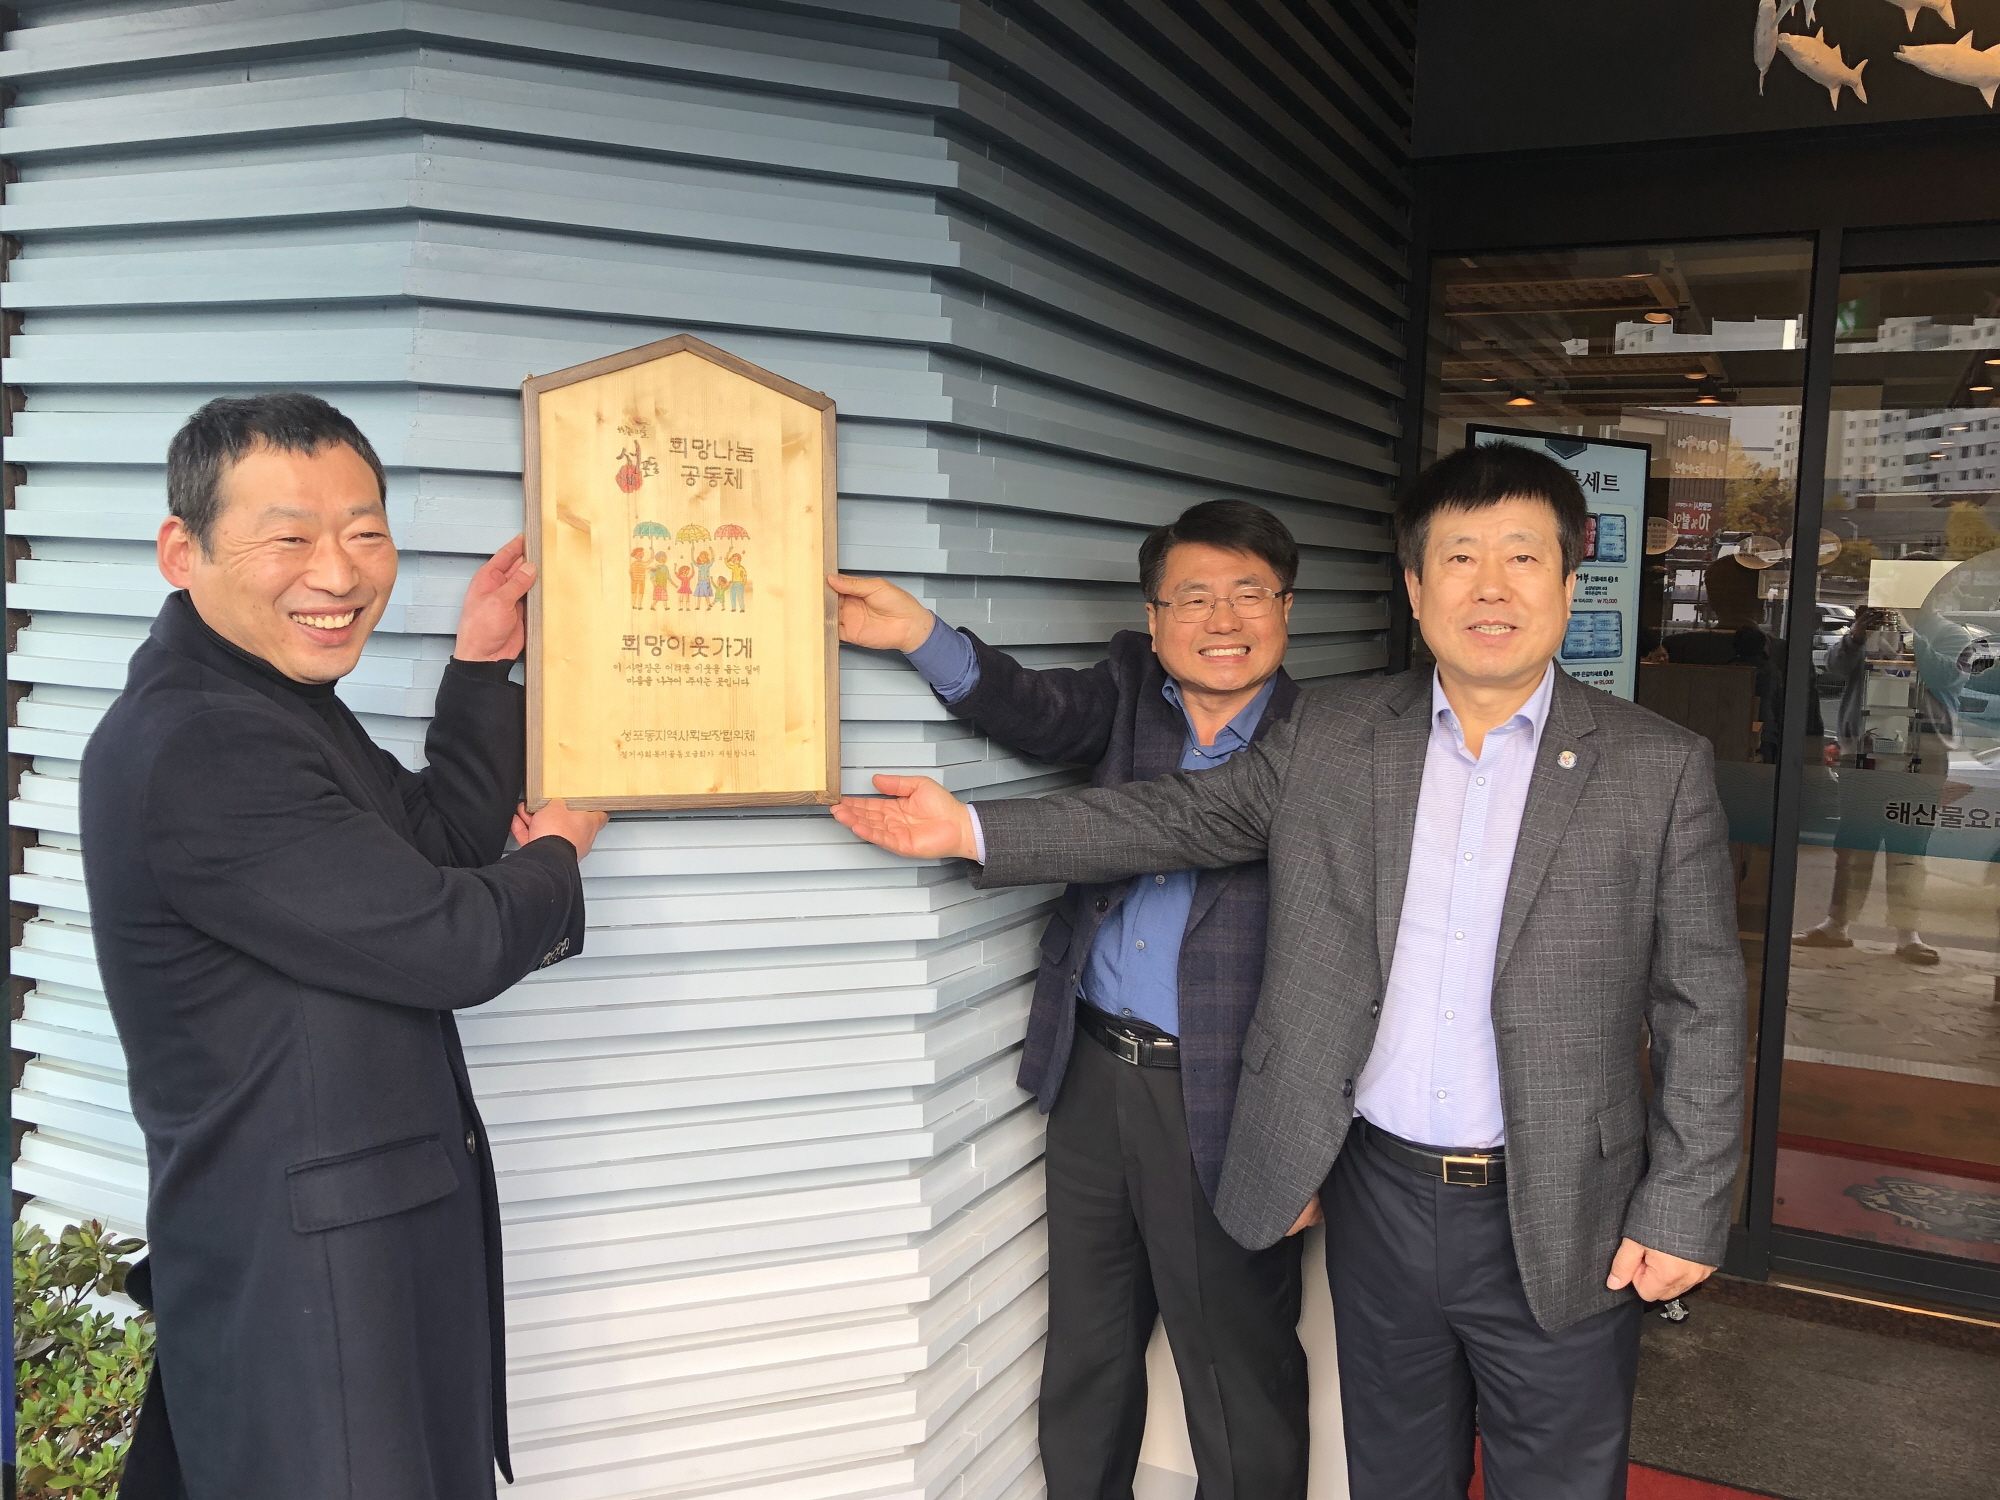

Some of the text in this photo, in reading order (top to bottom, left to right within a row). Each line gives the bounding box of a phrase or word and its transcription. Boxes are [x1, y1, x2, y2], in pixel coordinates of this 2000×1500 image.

[669, 437, 755, 463] 희망나눔
[681, 465, 743, 489] 공동체
[621, 634, 752, 659] 희망이웃가게
[613, 662, 622, 673] 이
[665, 663, 691, 674] 어려운
[695, 663, 720, 675] 이웃을
[627, 676, 653, 687] 마음을
[686, 676, 712, 687] 주시는
[716, 676, 750, 688] 곳입니다
